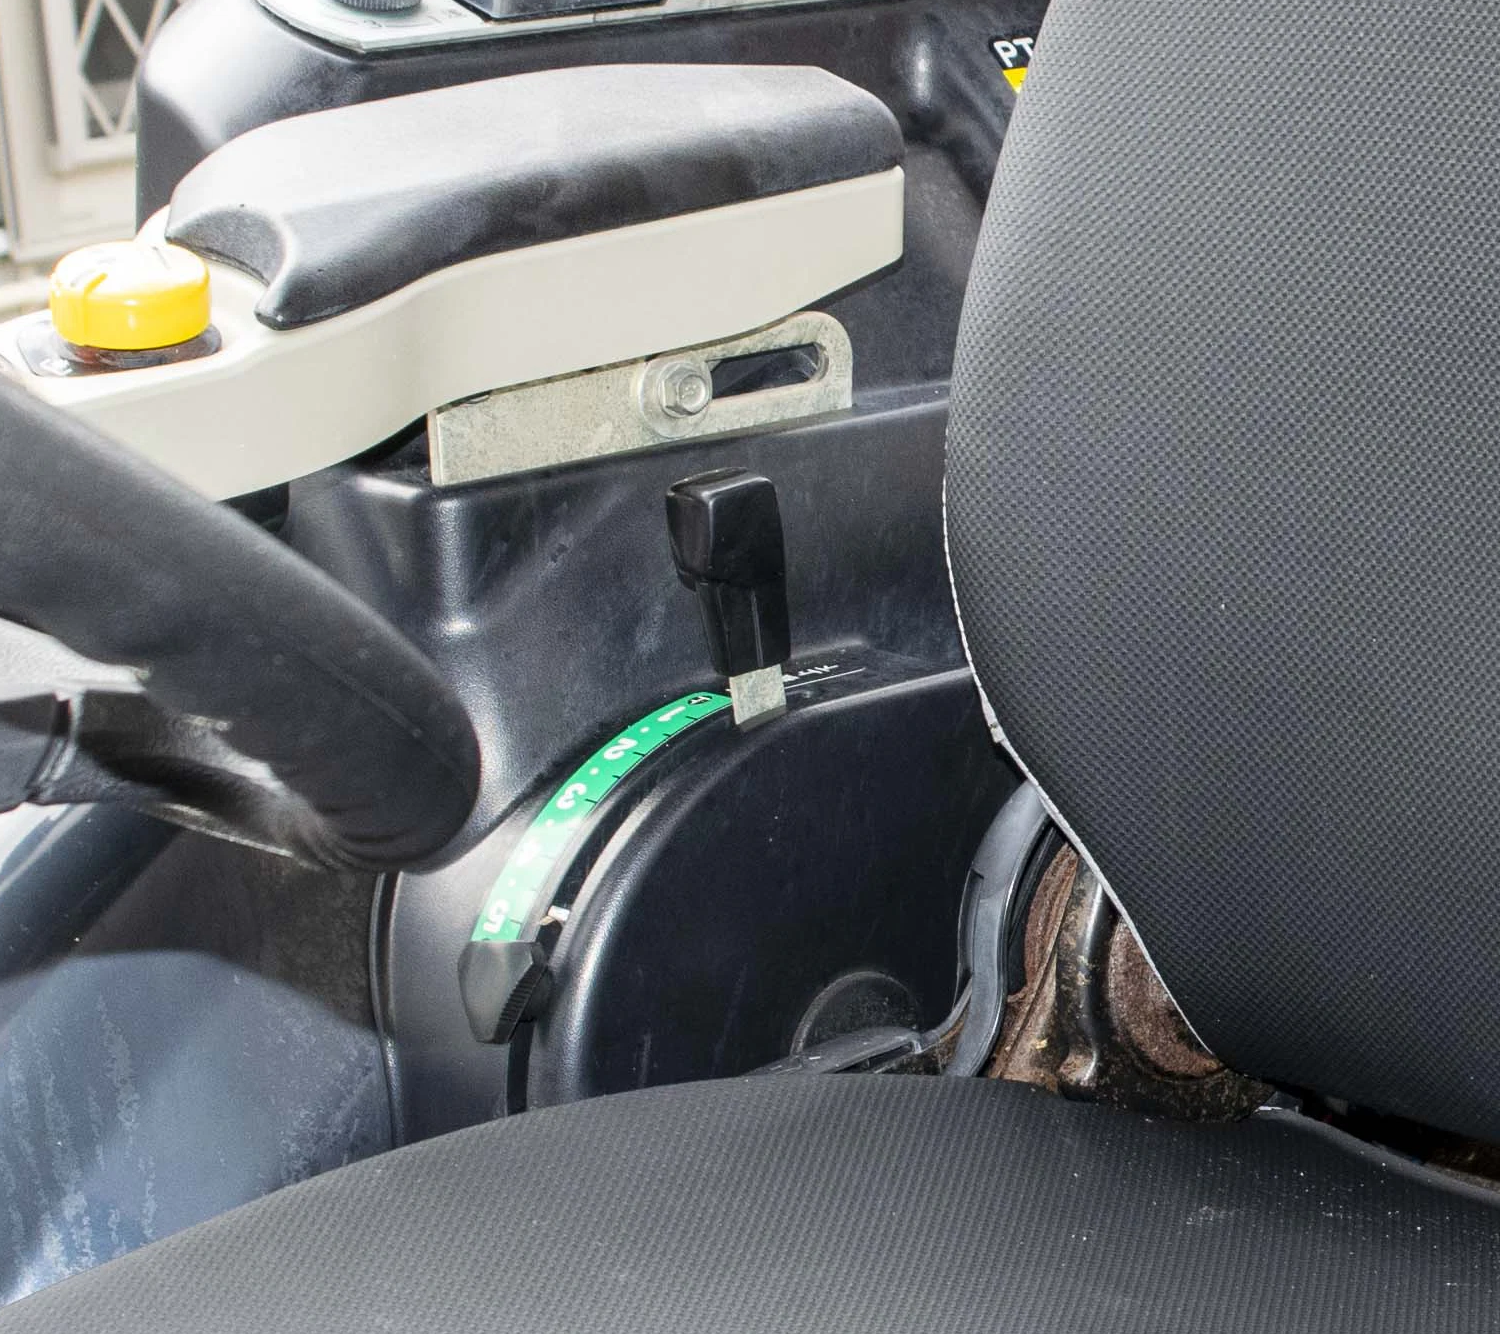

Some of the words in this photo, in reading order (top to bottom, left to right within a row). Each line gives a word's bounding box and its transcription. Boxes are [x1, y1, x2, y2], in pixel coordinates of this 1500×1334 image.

[993, 37, 1034, 68] PT
[603, 737, 639, 760] 2
[556, 782, 587, 810] 3
